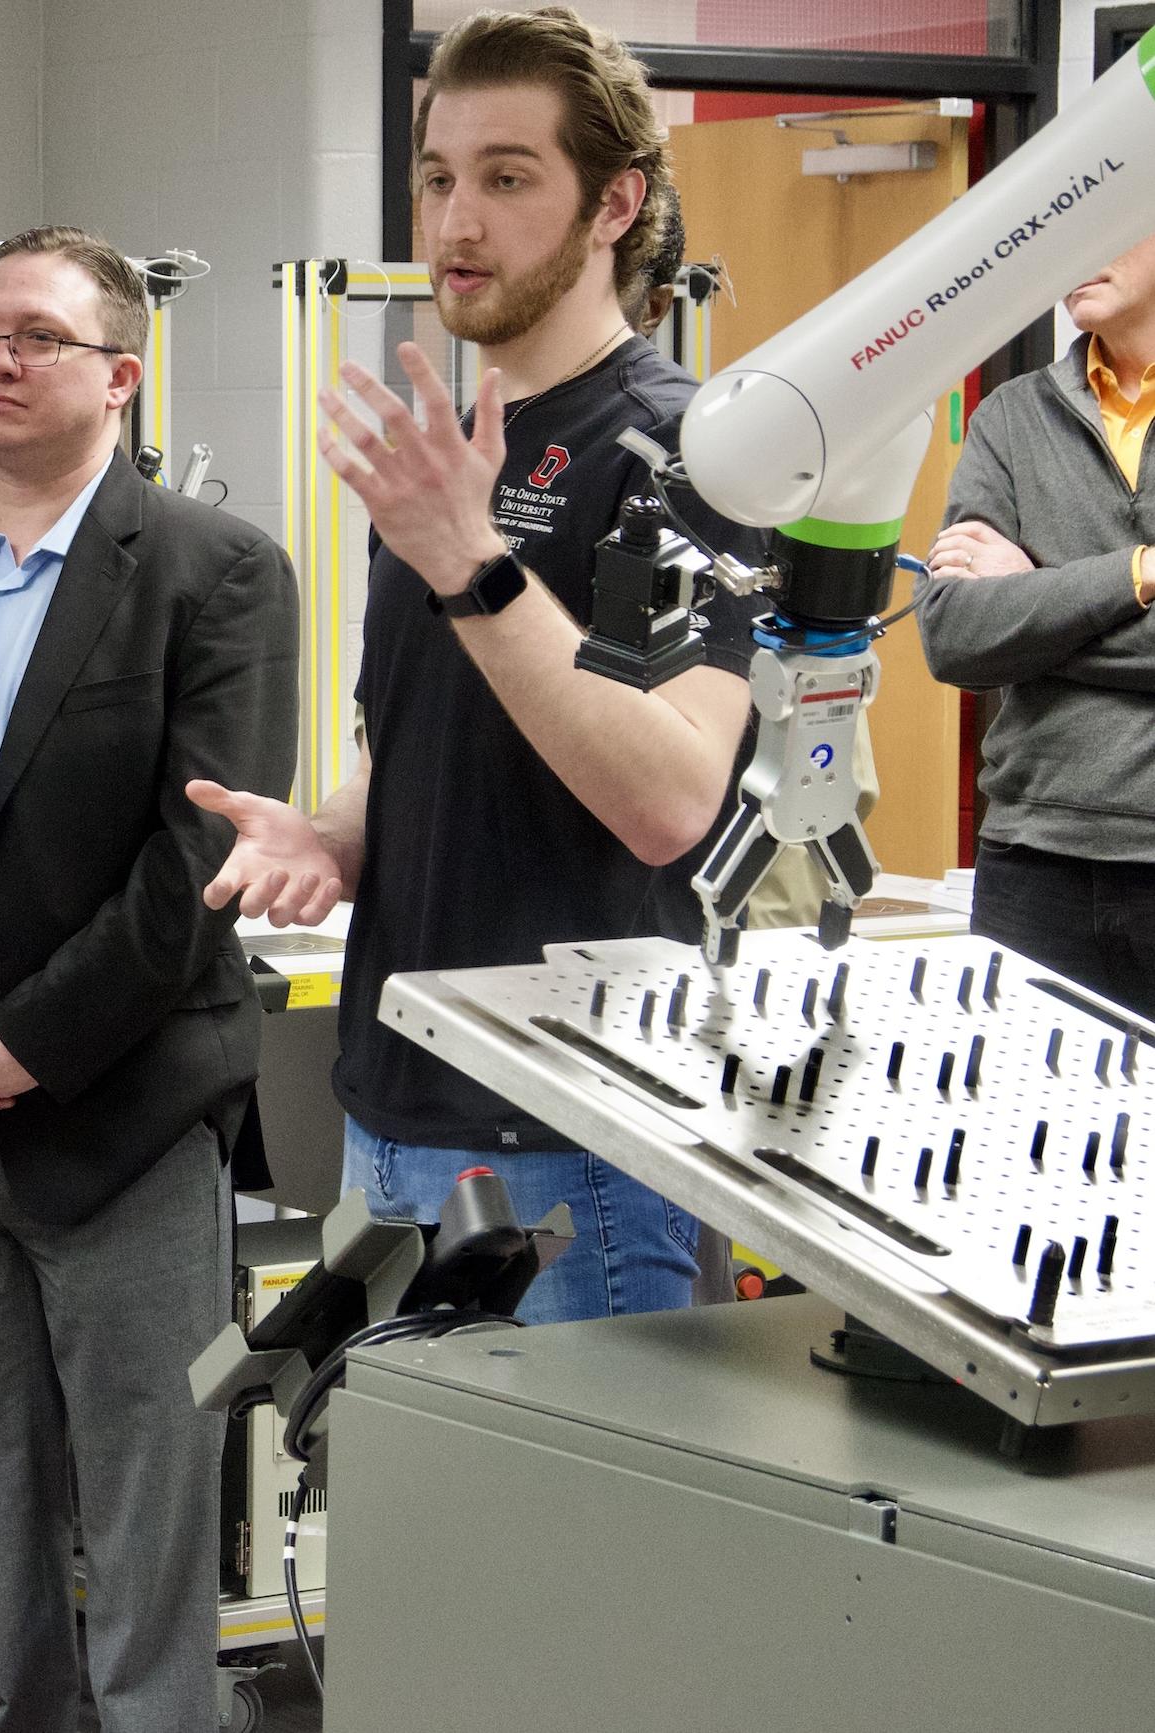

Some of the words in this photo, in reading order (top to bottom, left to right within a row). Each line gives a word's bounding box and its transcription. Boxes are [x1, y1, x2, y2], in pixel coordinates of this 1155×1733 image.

[850, 308, 925, 370] FANUC
[925, 257, 994, 313] Robot
[994, 157, 1124, 260] CRX-10iA/L
[499, 485, 517, 498] THE
[516, 488, 541, 503] OHIO
[539, 493, 568, 506] STATE
[500, 498, 553, 517] UNIVERSITY
[502, 534, 525, 549] SET
[262, 1278, 290, 1287] FANUC
